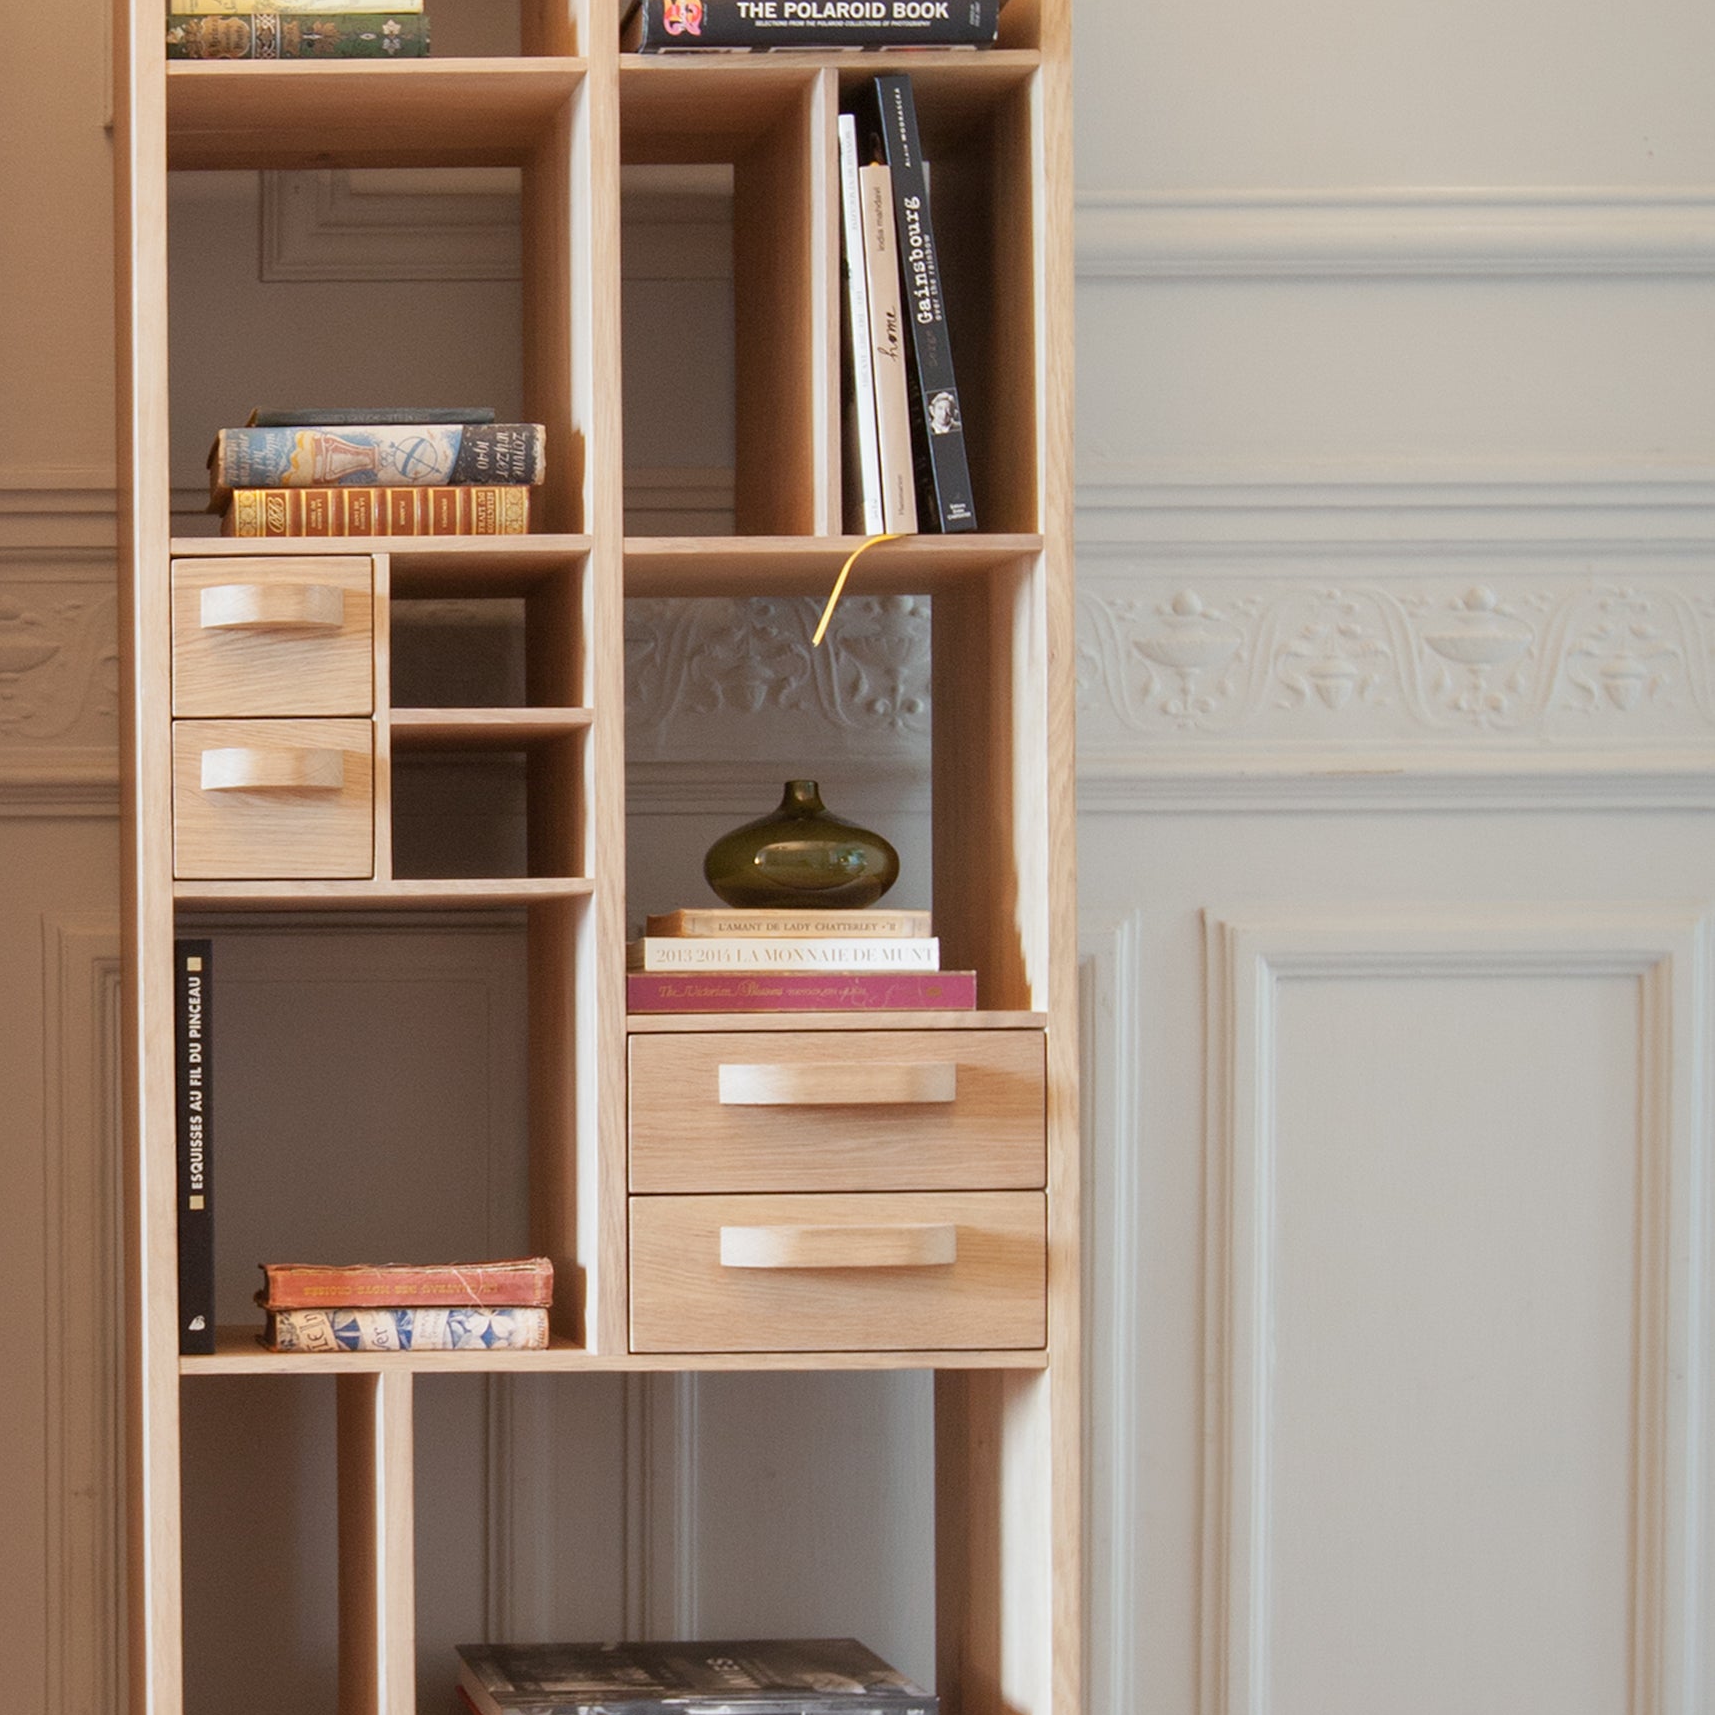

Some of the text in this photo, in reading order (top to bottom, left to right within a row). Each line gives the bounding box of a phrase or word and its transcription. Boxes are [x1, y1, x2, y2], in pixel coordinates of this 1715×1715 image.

[737, 0, 777, 19] THE
[784, 1, 886, 19] POLAROID
[892, 1, 949, 19] BOOK
[905, 195, 933, 324] Gainsbourg
[877, 305, 897, 362] home
[473, 440, 490, 470] 1940
[718, 922, 762, 931] L'AMANT
[766, 922, 780, 931] DE
[784, 922, 811, 931] LADY
[815, 922, 877, 931] CHATTERLEY
[656, 949, 693, 963] 2013
[736, 948, 759, 962] LA
[764, 948, 849, 962] MONNAIE
[853, 948, 879, 962] DE
[188, 976, 203, 1190] ESQUISSES AU FIL DU PINCEAU
